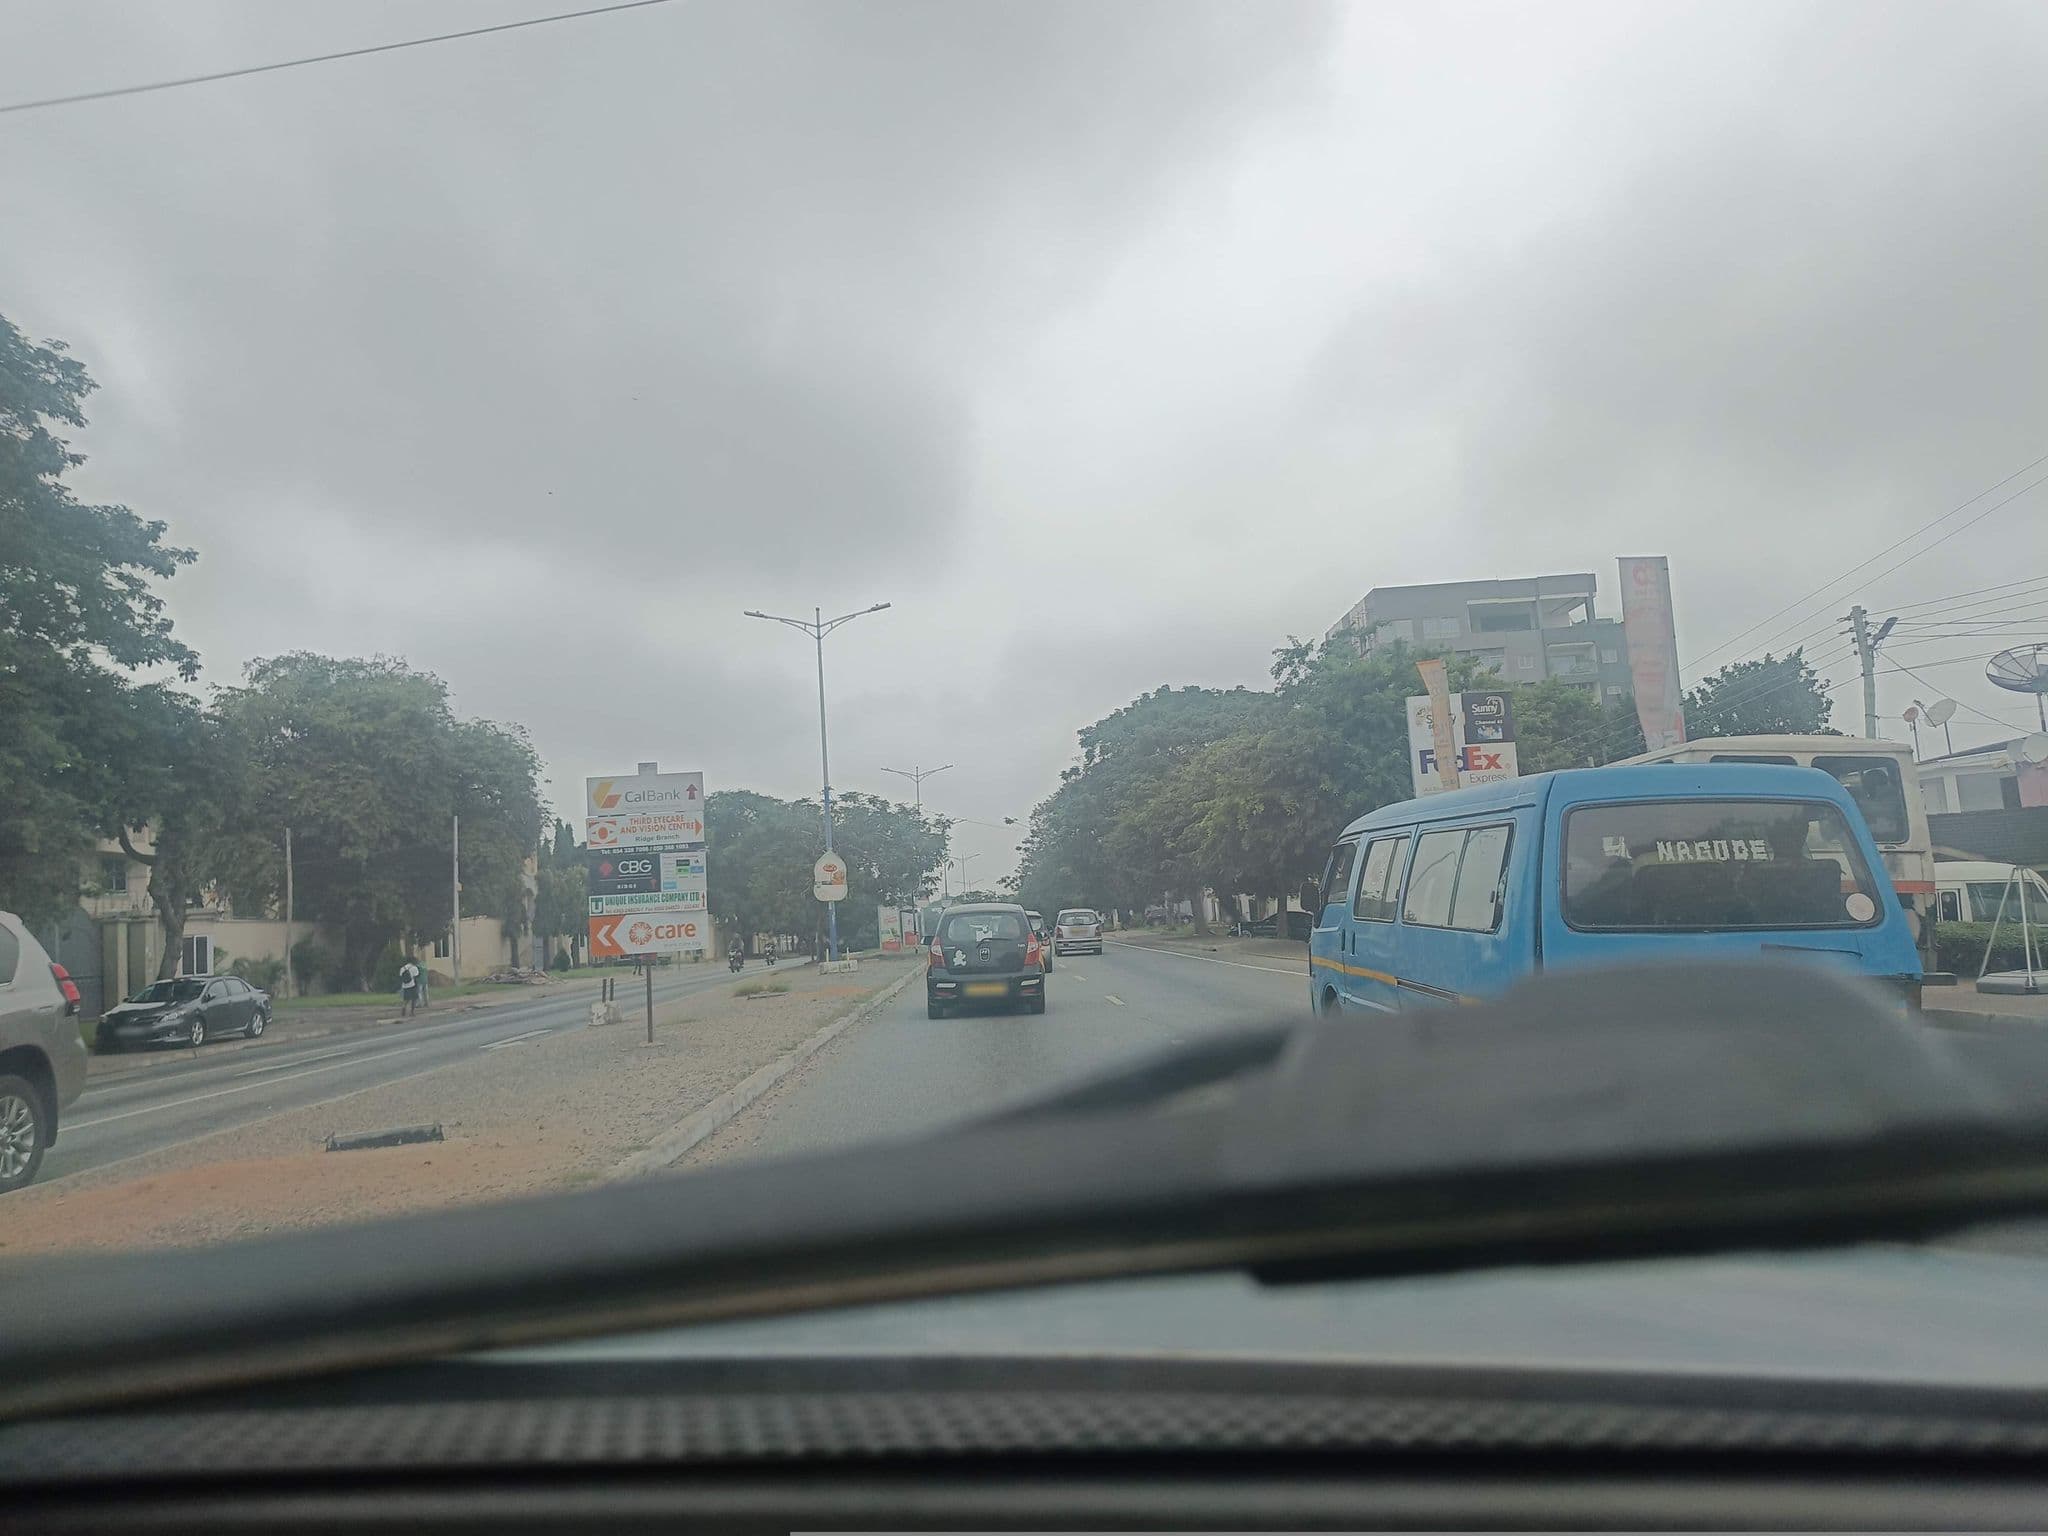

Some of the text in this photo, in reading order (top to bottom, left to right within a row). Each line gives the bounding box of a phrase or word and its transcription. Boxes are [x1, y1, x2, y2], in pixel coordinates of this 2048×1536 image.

[1471, 704, 1497, 714] Sunny
[1419, 746, 1502, 774] FdEx
[1469, 773, 1507, 783] Express
[624, 788, 681, 803] CalBank
[629, 815, 685, 826] THIRD EYECARE
[620, 822, 694, 834] AND VISION CENTRE
[618, 860, 652, 874] CBG
[605, 891, 700, 905] UNIQUE INSURANCE COMPANY LTD
[655, 923, 696, 940] care
